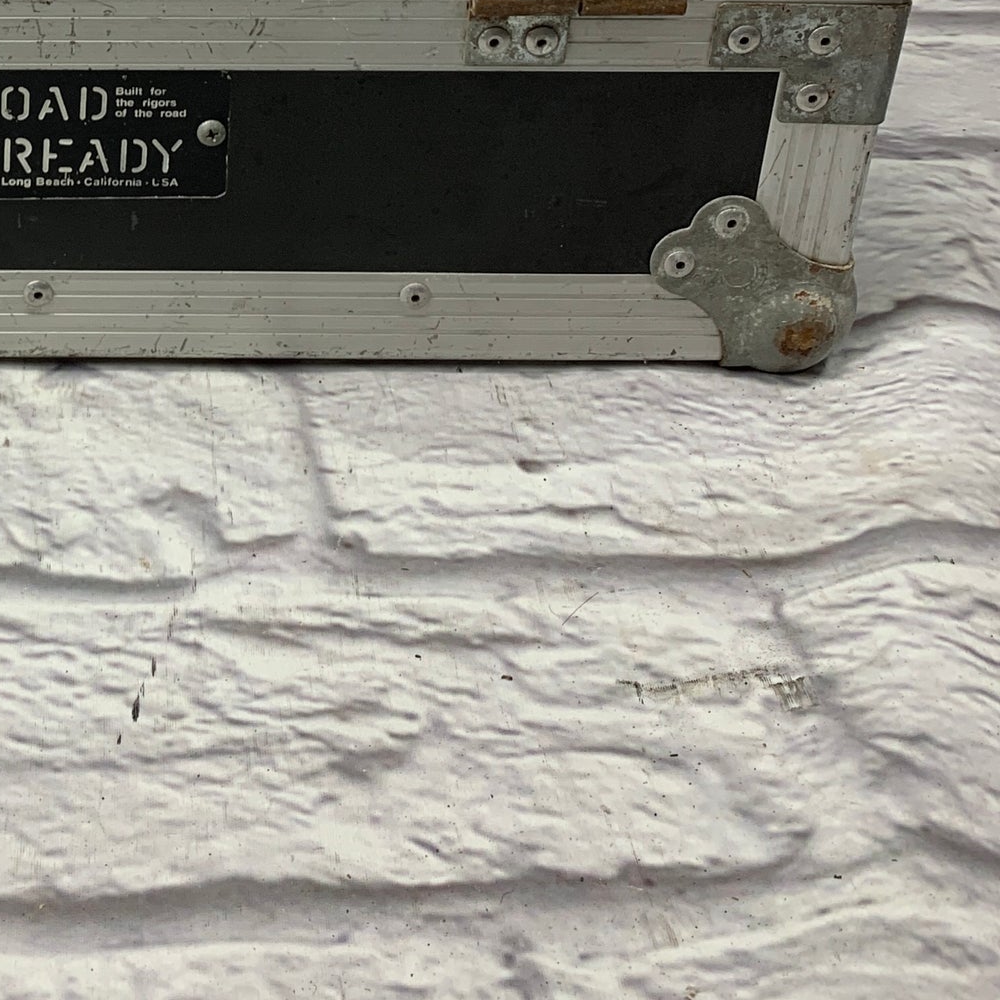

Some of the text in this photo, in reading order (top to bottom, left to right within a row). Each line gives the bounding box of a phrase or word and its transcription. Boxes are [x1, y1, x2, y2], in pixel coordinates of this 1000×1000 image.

[115, 86, 167, 96] Built for
[115, 97, 177, 109] the rigors
[114, 108, 187, 118] of the road
[3, 137, 183, 174] READY
[1, 177, 179, 188] Long Beach California USA
